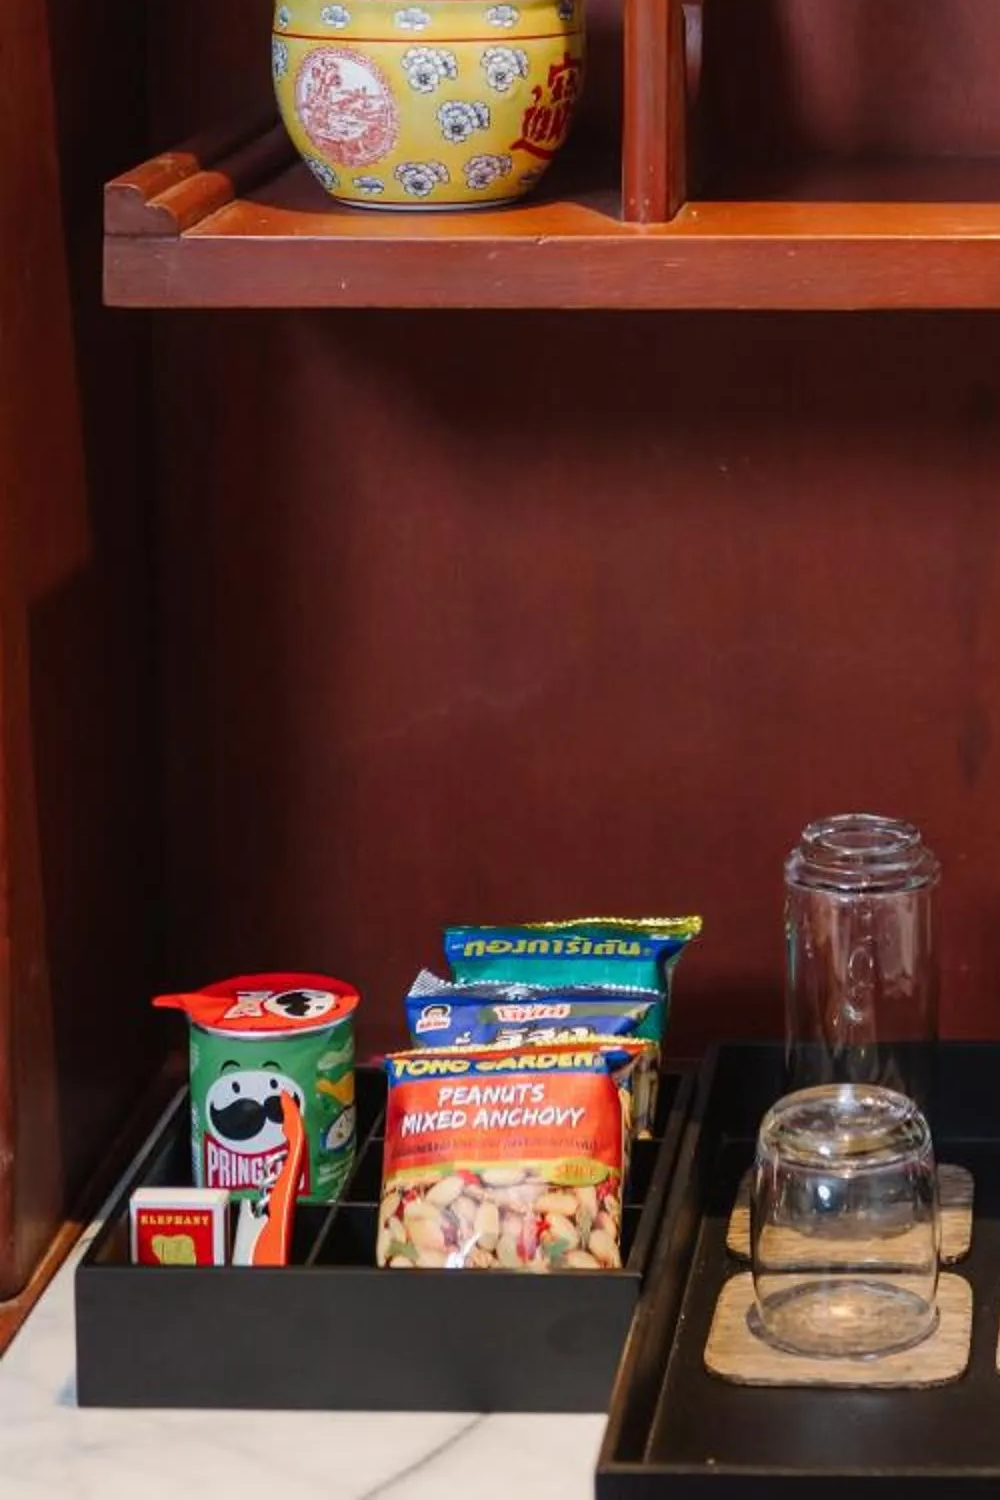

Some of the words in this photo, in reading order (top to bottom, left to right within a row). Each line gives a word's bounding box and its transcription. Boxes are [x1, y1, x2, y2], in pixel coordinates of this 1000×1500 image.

[438, 1084, 545, 1107] PEANUTS
[402, 1108, 467, 1138] MIXED
[473, 1106, 585, 1132] ANCHOVY
[140, 1214, 210, 1226] ELEPHANT
